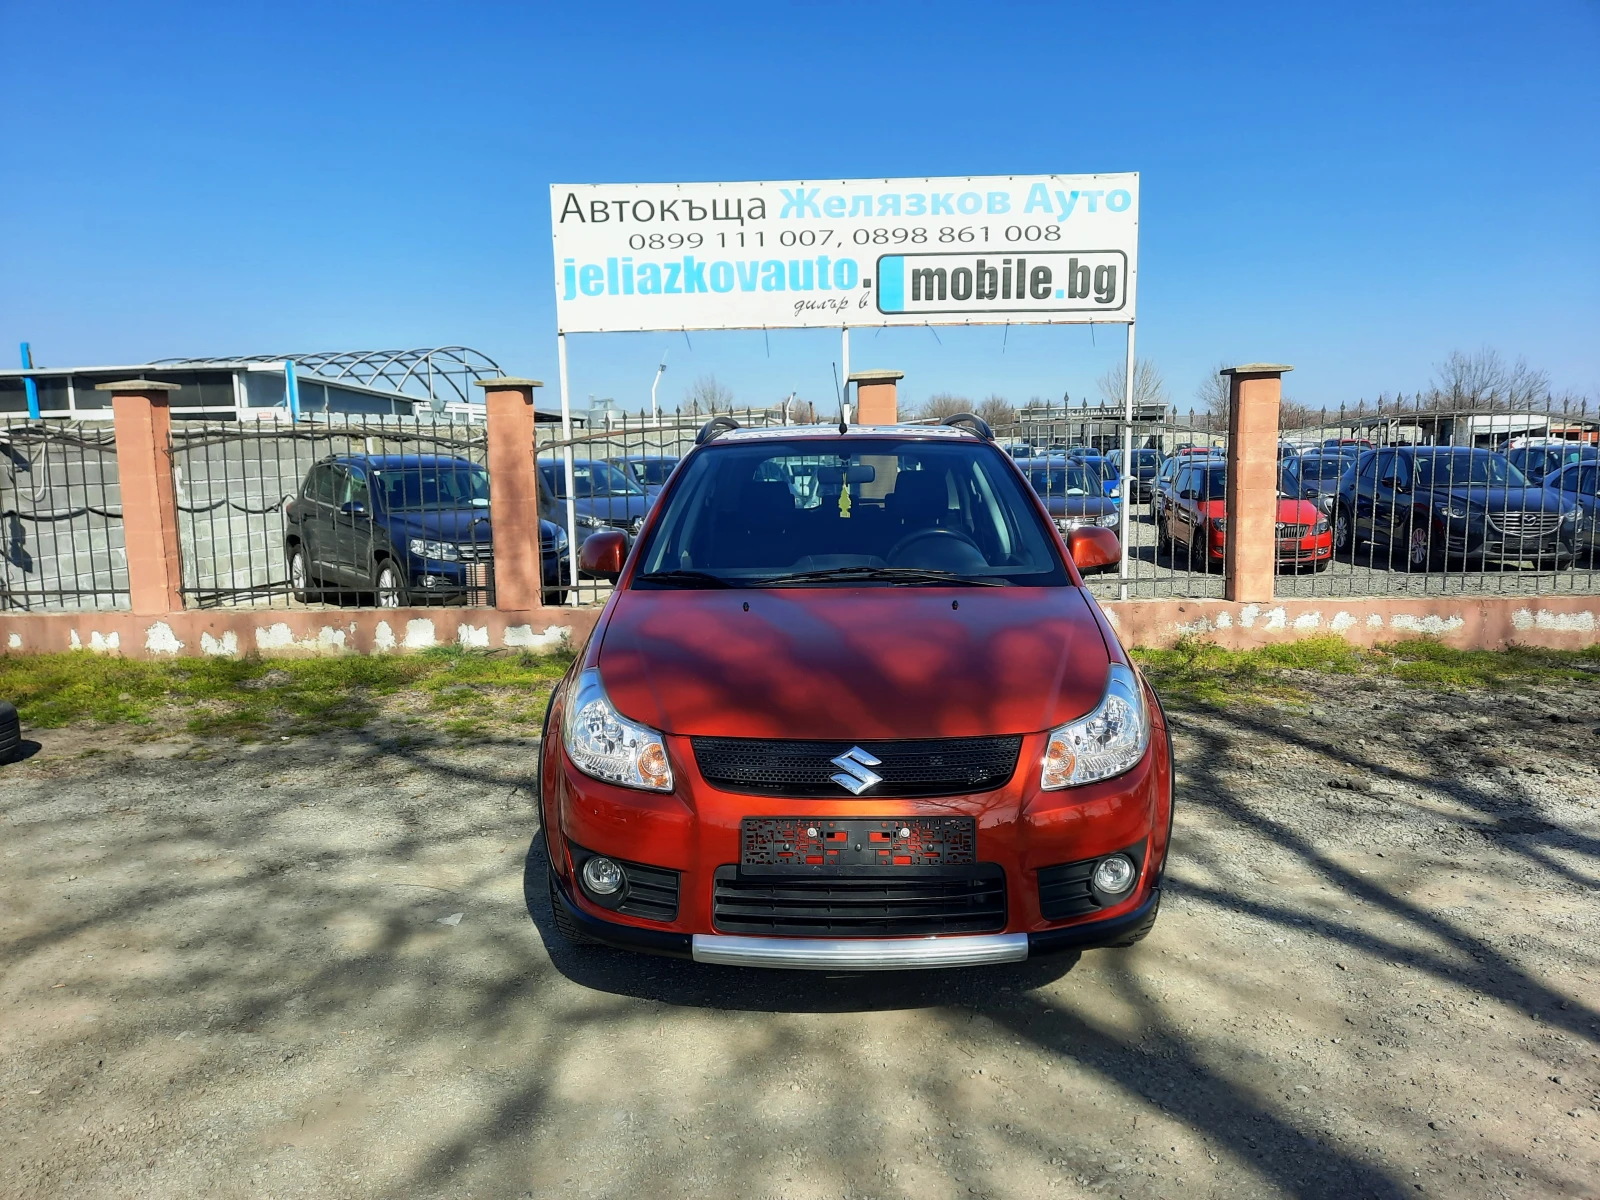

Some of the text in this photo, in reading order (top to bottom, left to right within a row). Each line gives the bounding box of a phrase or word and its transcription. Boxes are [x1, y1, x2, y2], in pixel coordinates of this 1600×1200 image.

[559, 182, 1132, 226] Автокъща Желязков Ауто
[629, 224, 1062, 250] 0899 111 007, 0898 861 008
[911, 257, 1117, 304] mobile.bg
[794, 290, 870, 317] дилър в
